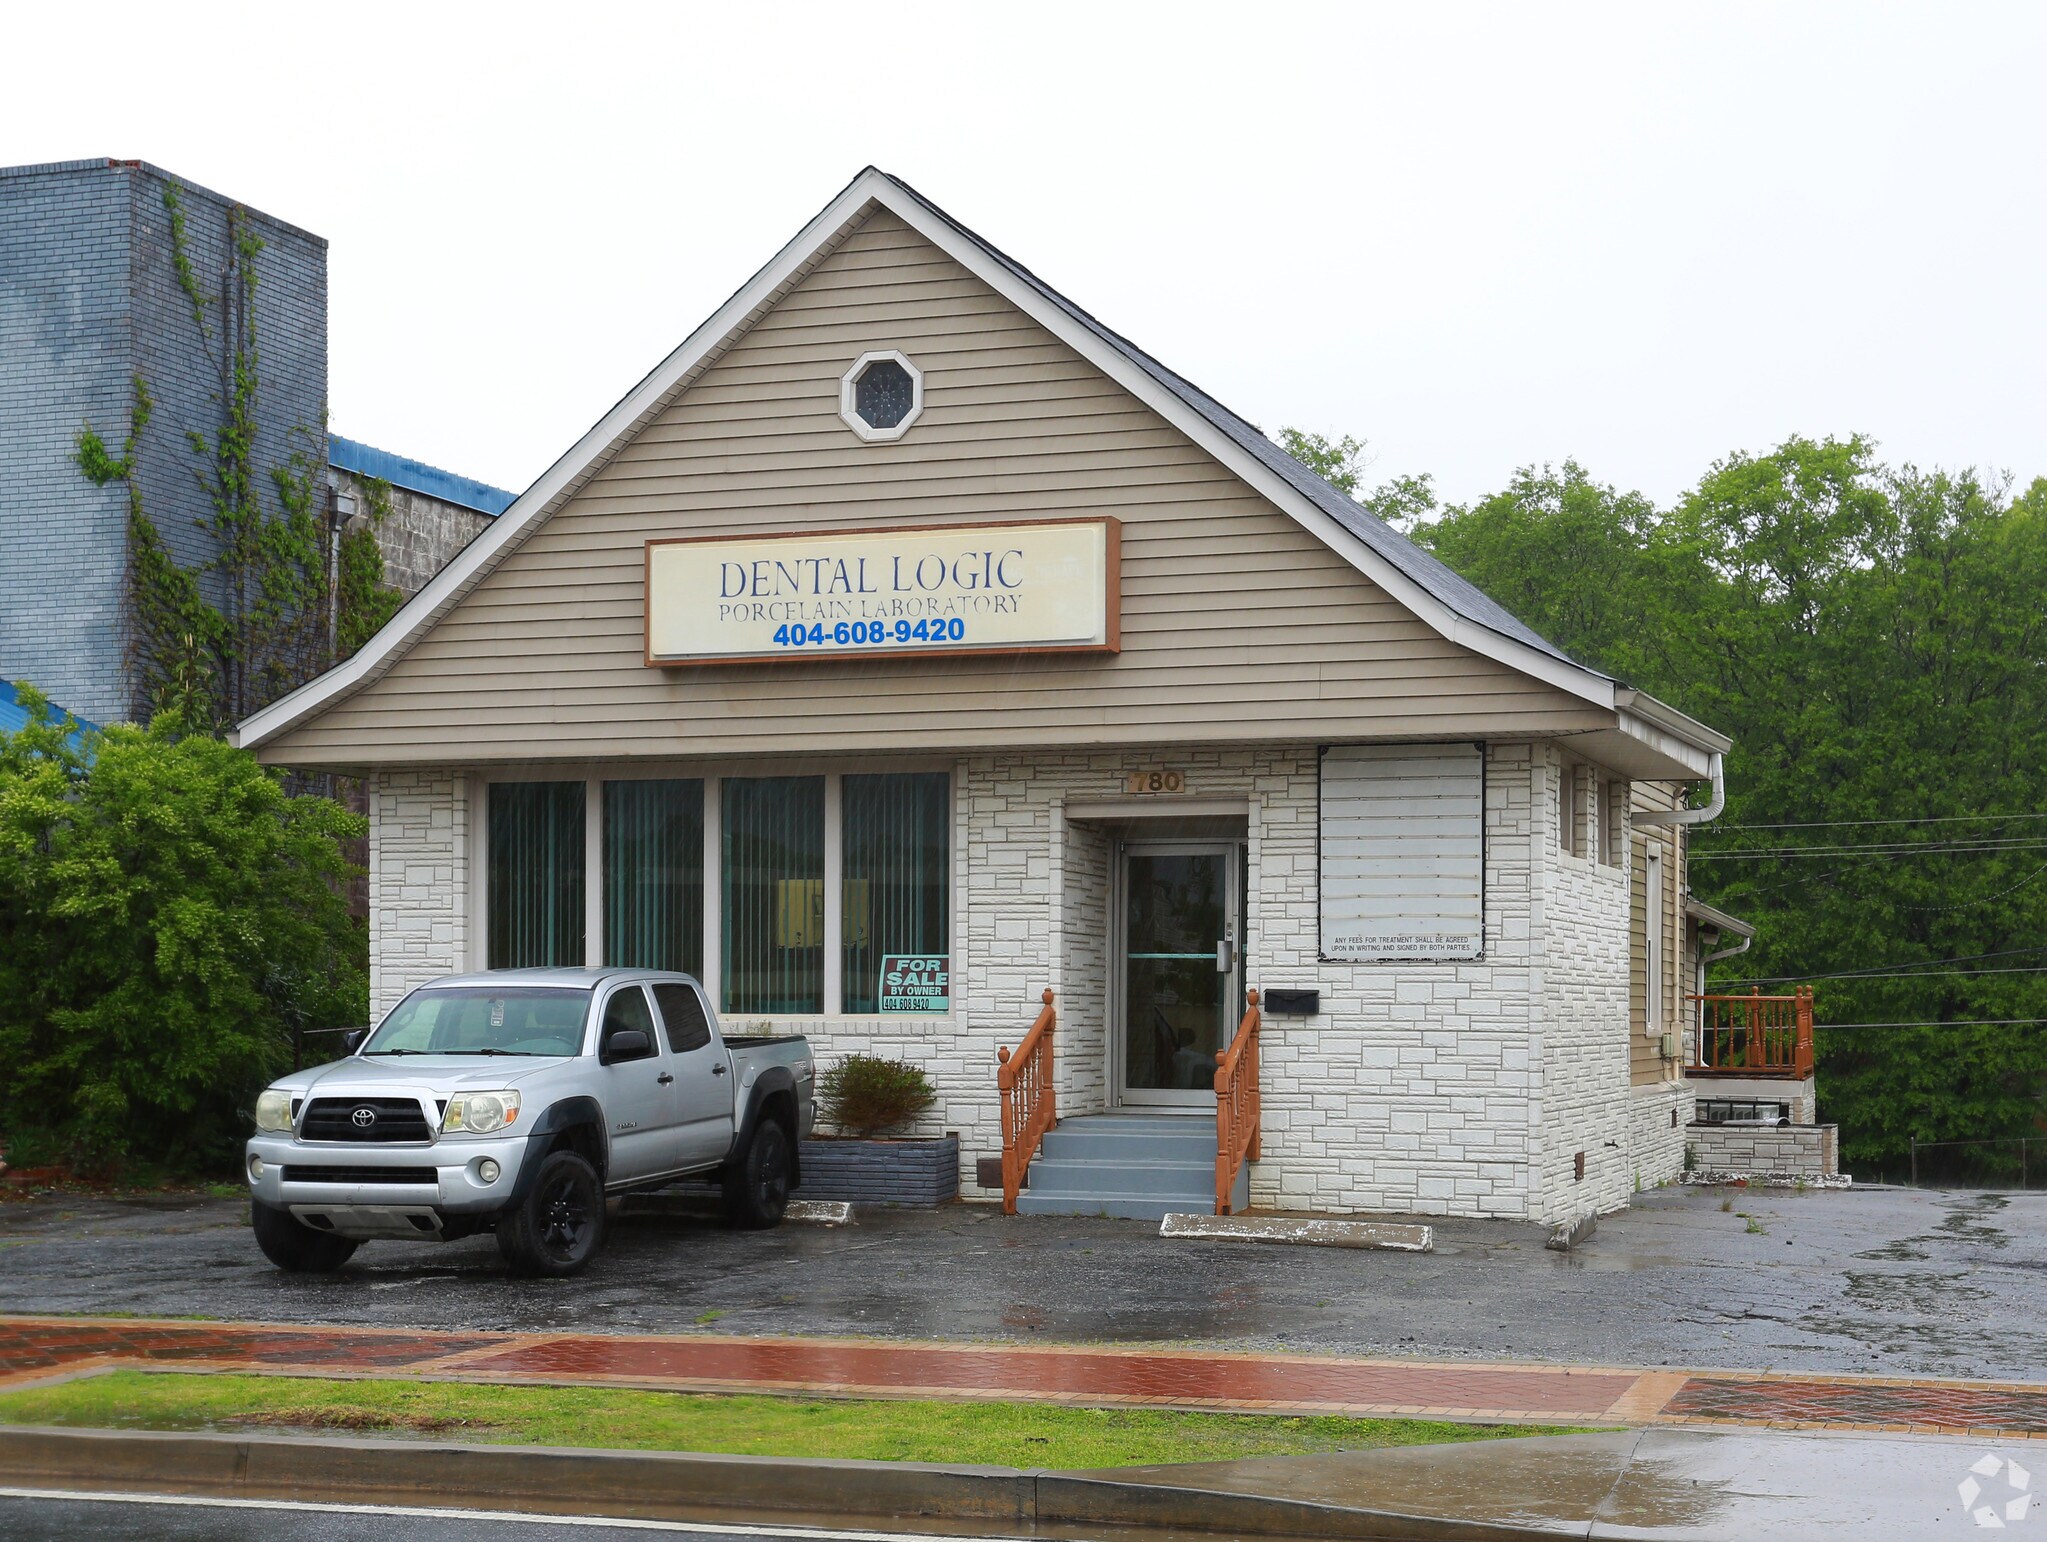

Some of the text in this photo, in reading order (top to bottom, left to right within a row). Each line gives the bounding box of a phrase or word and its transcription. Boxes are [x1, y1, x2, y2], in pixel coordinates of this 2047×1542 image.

[720, 550, 1024, 598] DENTAL LOGIC
[719, 595, 1023, 622] PORCELAIN LABORATORY
[773, 618, 965, 646] 404-608-9420
[1134, 772, 1180, 791] 780
[1334, 936, 1469, 944] ANY FEES FOR TREATMENT SHALL BE AGREED
[896, 959, 941, 971] FOR
[886, 972, 949, 986] SALE
[890, 986, 942, 995] BY OWNER
[884, 998, 897, 1009] 404
